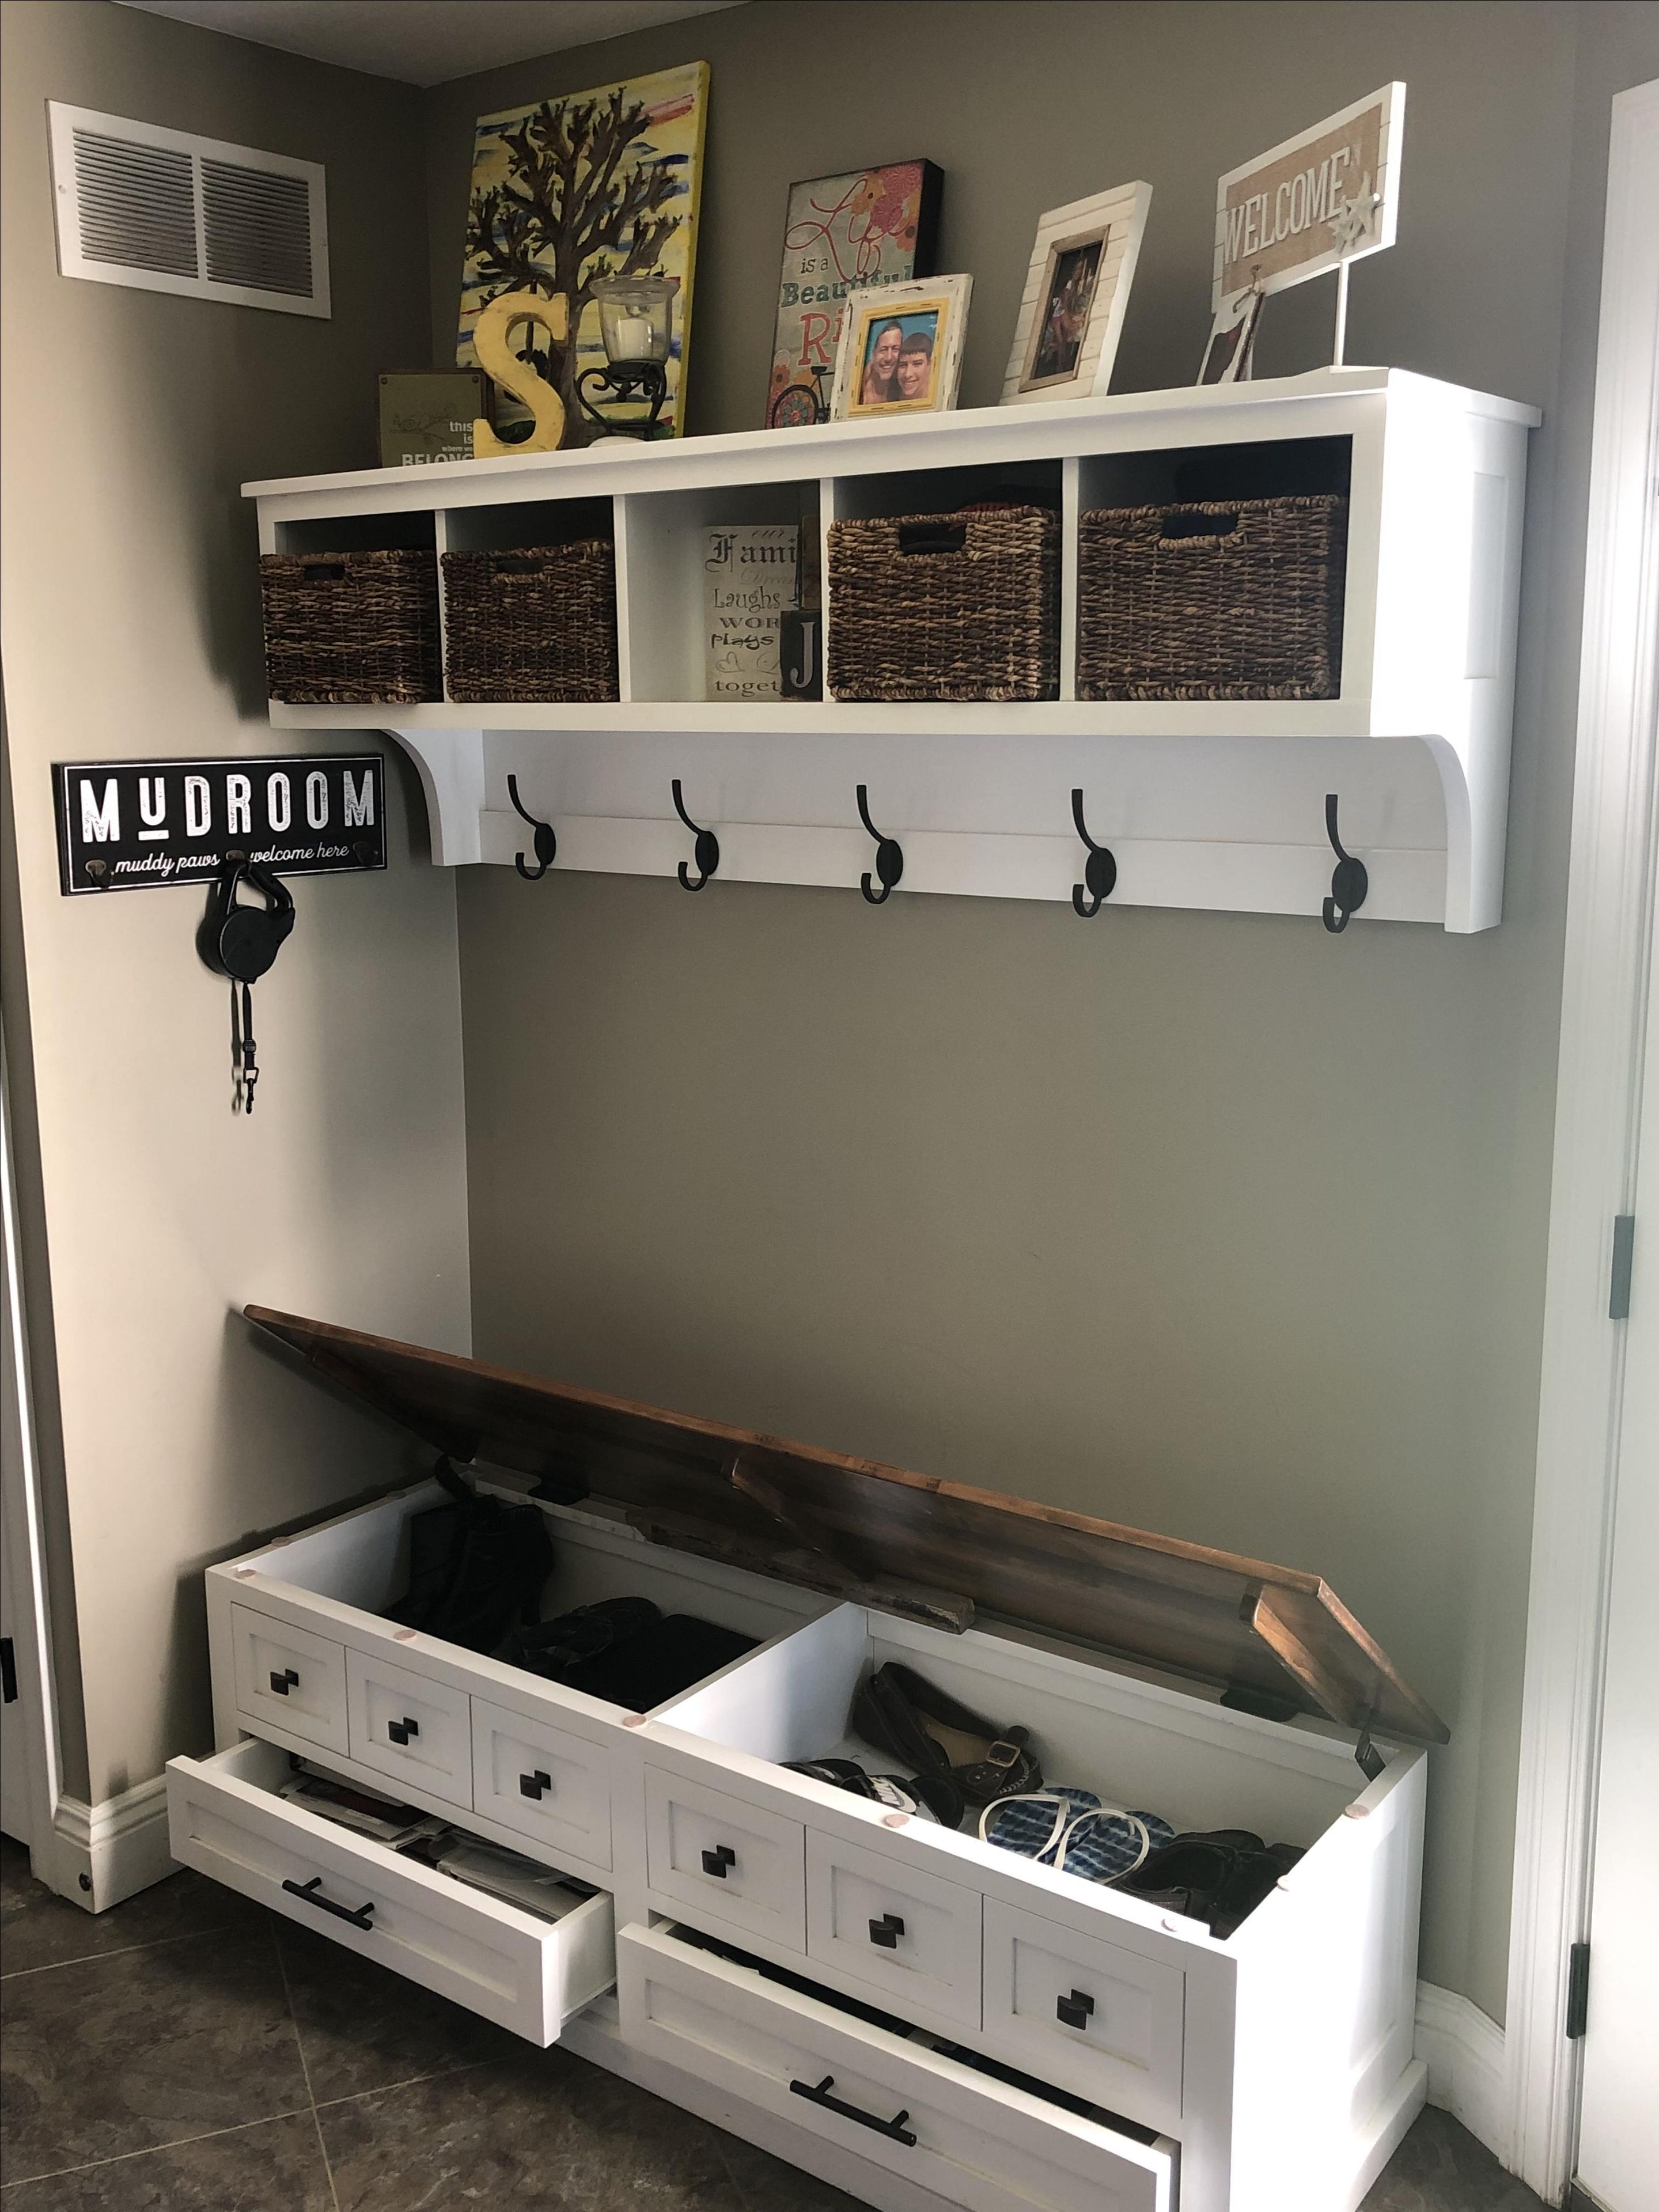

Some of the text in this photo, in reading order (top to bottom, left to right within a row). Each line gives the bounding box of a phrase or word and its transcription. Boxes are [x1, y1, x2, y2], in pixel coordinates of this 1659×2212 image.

[1223, 146, 1351, 265] WELCOME
[800, 257, 829, 274] is a
[472, 291, 569, 460] S
[450, 422, 473, 432] this
[463, 433, 473, 444] is
[713, 586, 781, 613] Laughs
[790, 621, 816, 688] J
[79, 769, 374, 843] MUDROOM
[115, 842, 349, 878] muddy paws welcome here
